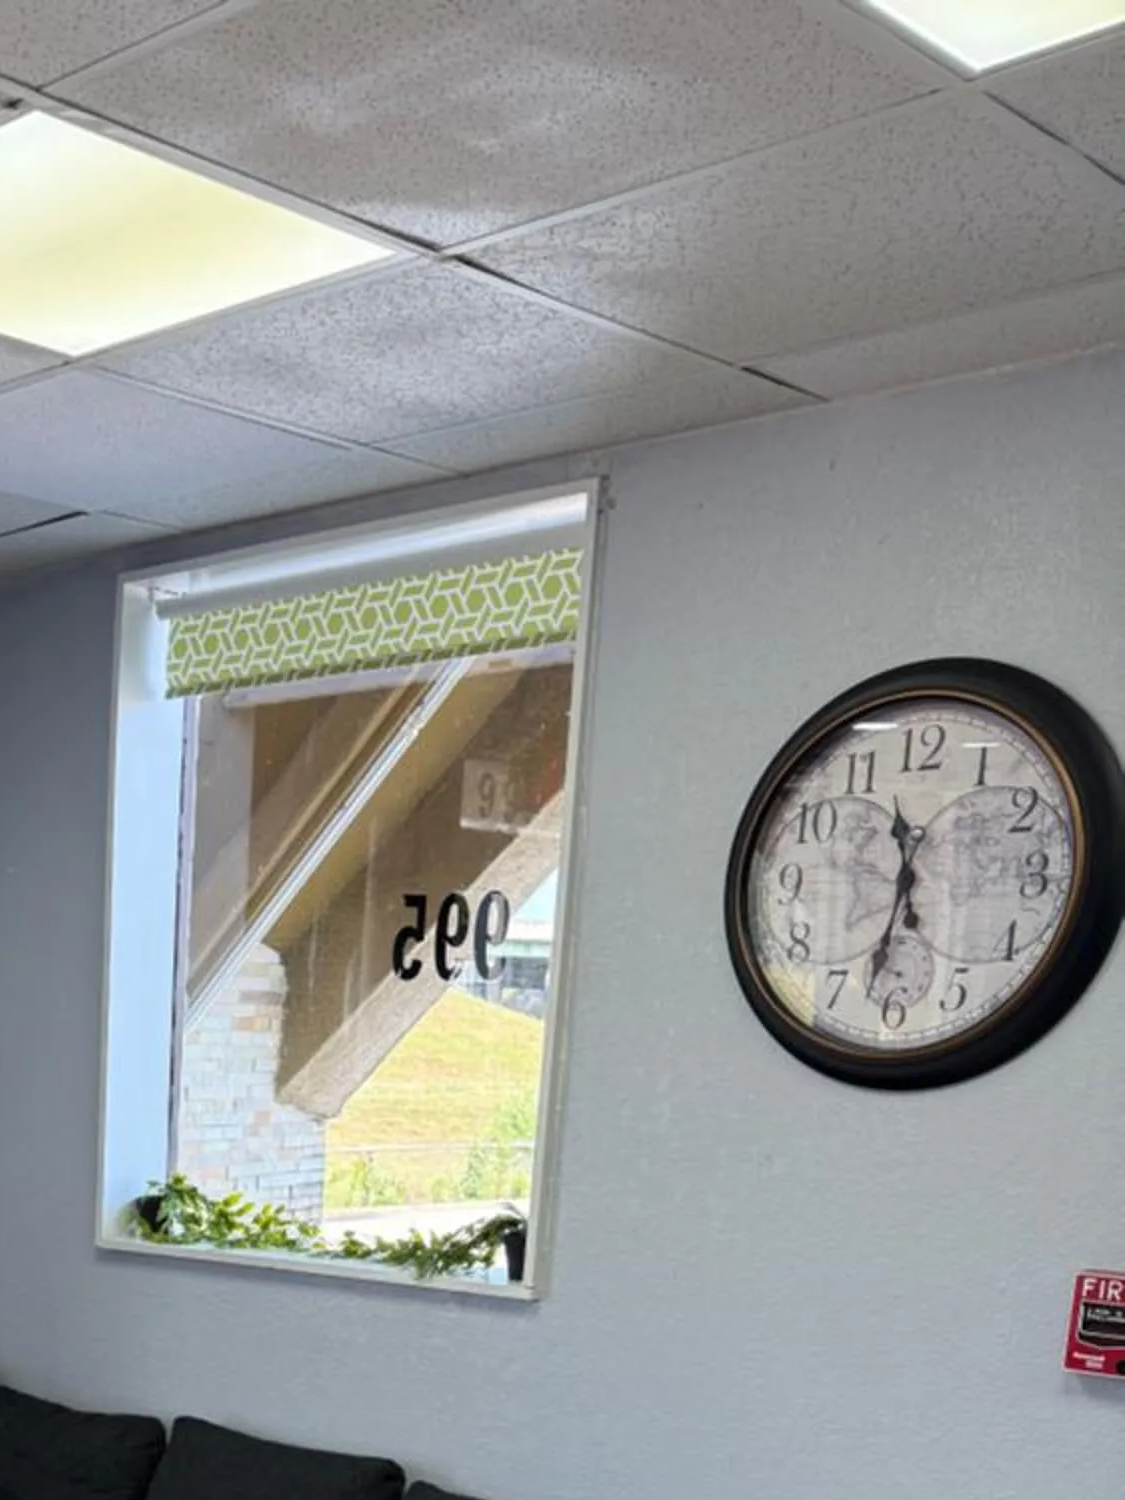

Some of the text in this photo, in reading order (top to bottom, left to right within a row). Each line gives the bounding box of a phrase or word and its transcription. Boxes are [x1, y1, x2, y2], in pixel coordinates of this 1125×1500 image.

[899, 724, 946, 773] 12
[975, 747, 987, 786] 1
[845, 751, 876, 795] 11
[797, 801, 838, 844] 10
[1008, 786, 1038, 833] 2
[779, 864, 803, 906] 9
[1020, 851, 1050, 898] 3
[786, 922, 812, 963] 8
[993, 919, 1020, 962] 4
[825, 969, 849, 1010] 7
[881, 987, 907, 1030] 6
[939, 968, 970, 1012] 5
[1081, 1278, 1125, 1301] FIR
